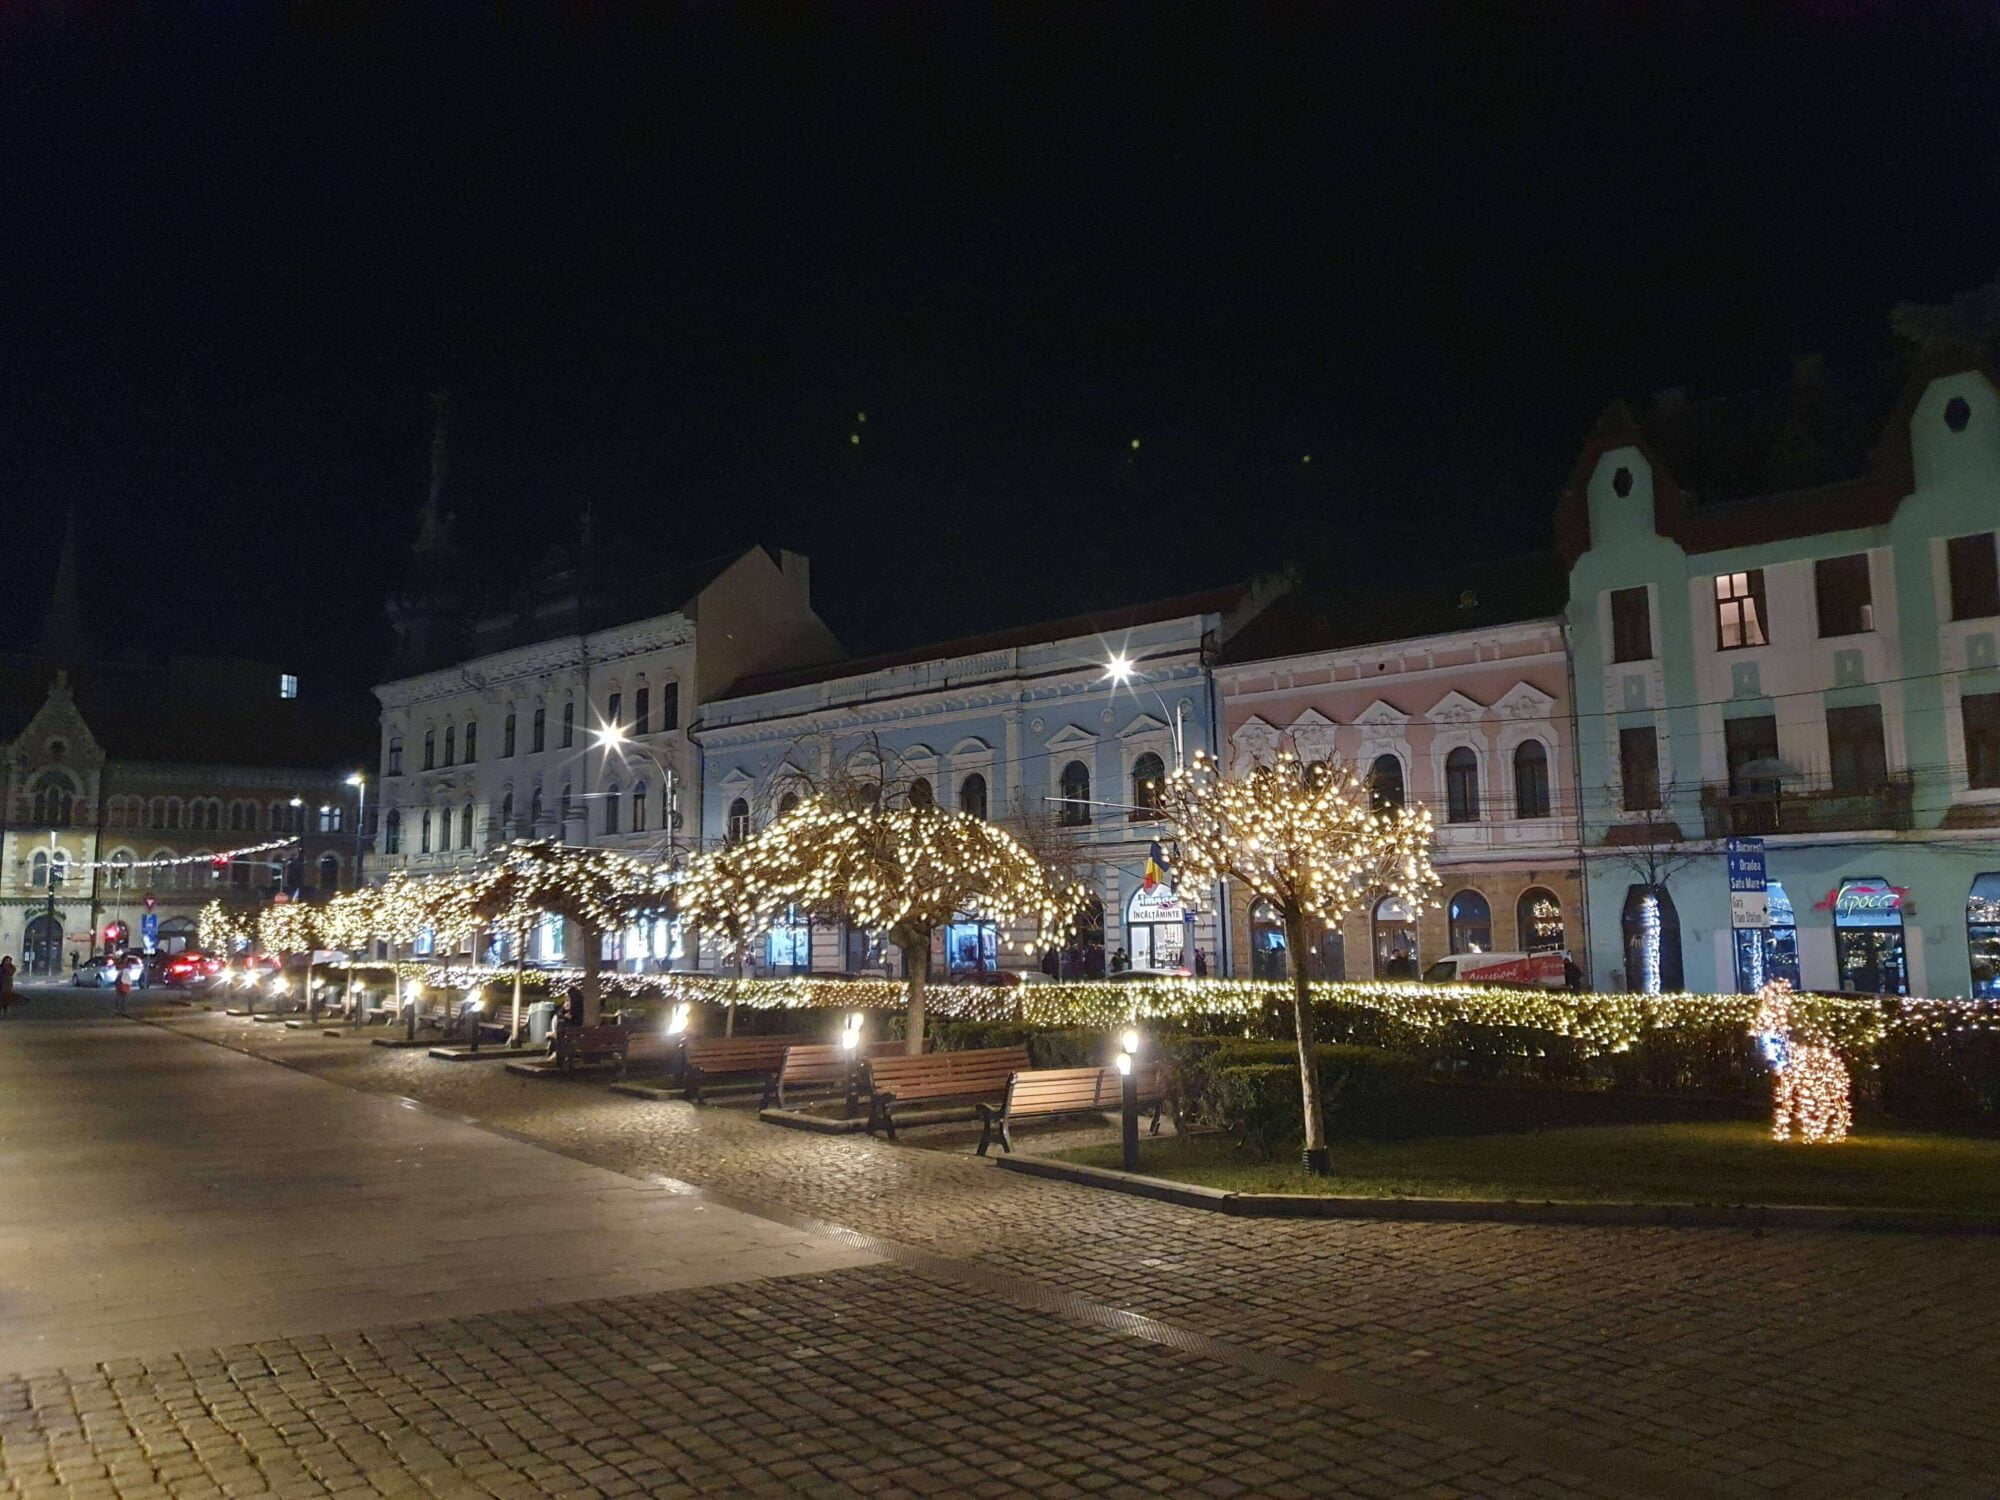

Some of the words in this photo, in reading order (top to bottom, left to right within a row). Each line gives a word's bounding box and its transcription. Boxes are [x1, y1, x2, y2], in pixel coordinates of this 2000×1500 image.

[1739, 859, 1761, 871] Oradea
[1731, 877, 1744, 889] Satu
[1745, 877, 1760, 889] Mare
